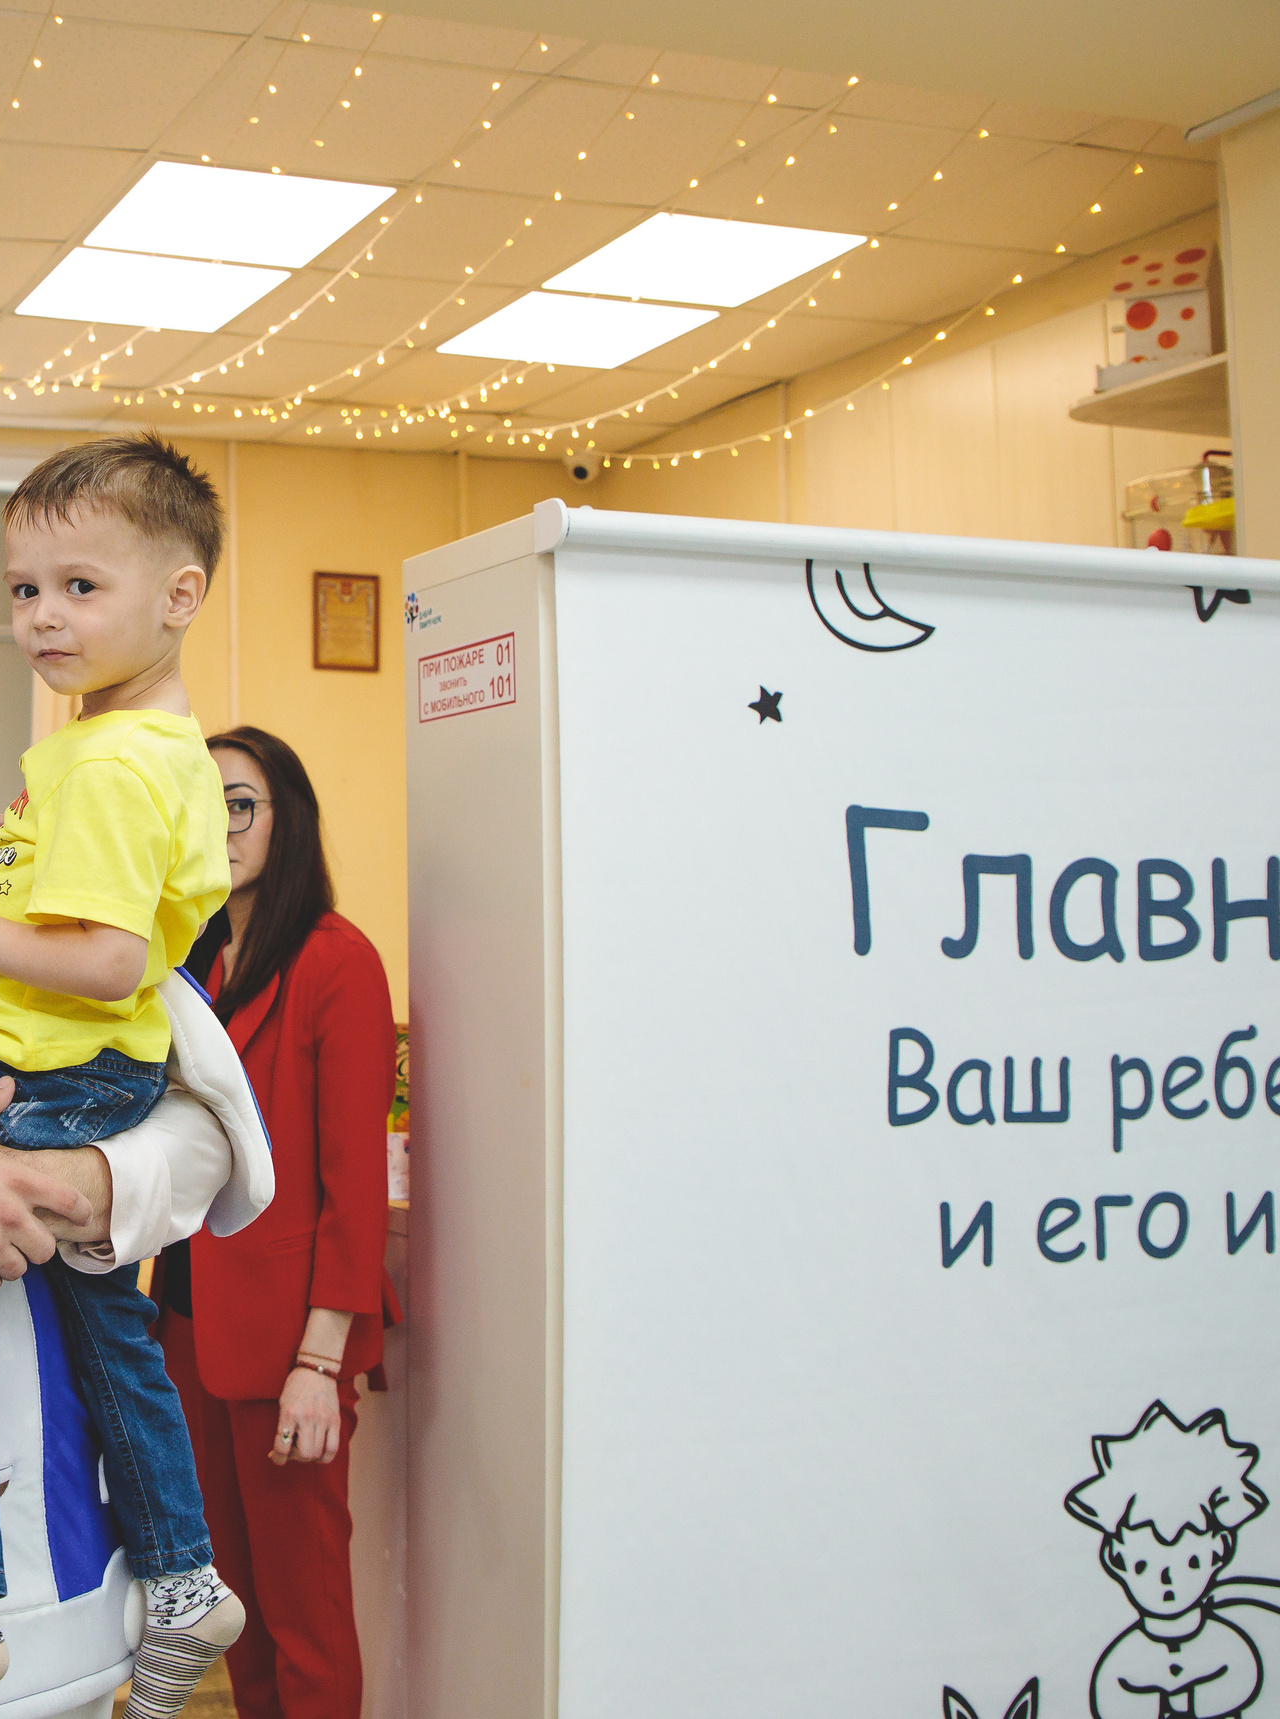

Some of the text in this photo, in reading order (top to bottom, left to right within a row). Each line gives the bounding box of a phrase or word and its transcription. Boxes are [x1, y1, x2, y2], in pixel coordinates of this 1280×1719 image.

[422, 640, 511, 679] ПРИ ПОЖАРЕ 01
[438, 676, 468, 692] ЗВОНИТЬ
[423, 672, 511, 715] С МОБИЛЬНОГО 101
[845, 804, 1280, 963] Главн
[888, 1026, 1070, 1127] Ваш
[940, 1200, 994, 1269] и
[1036, 1191, 1189, 1263] его
